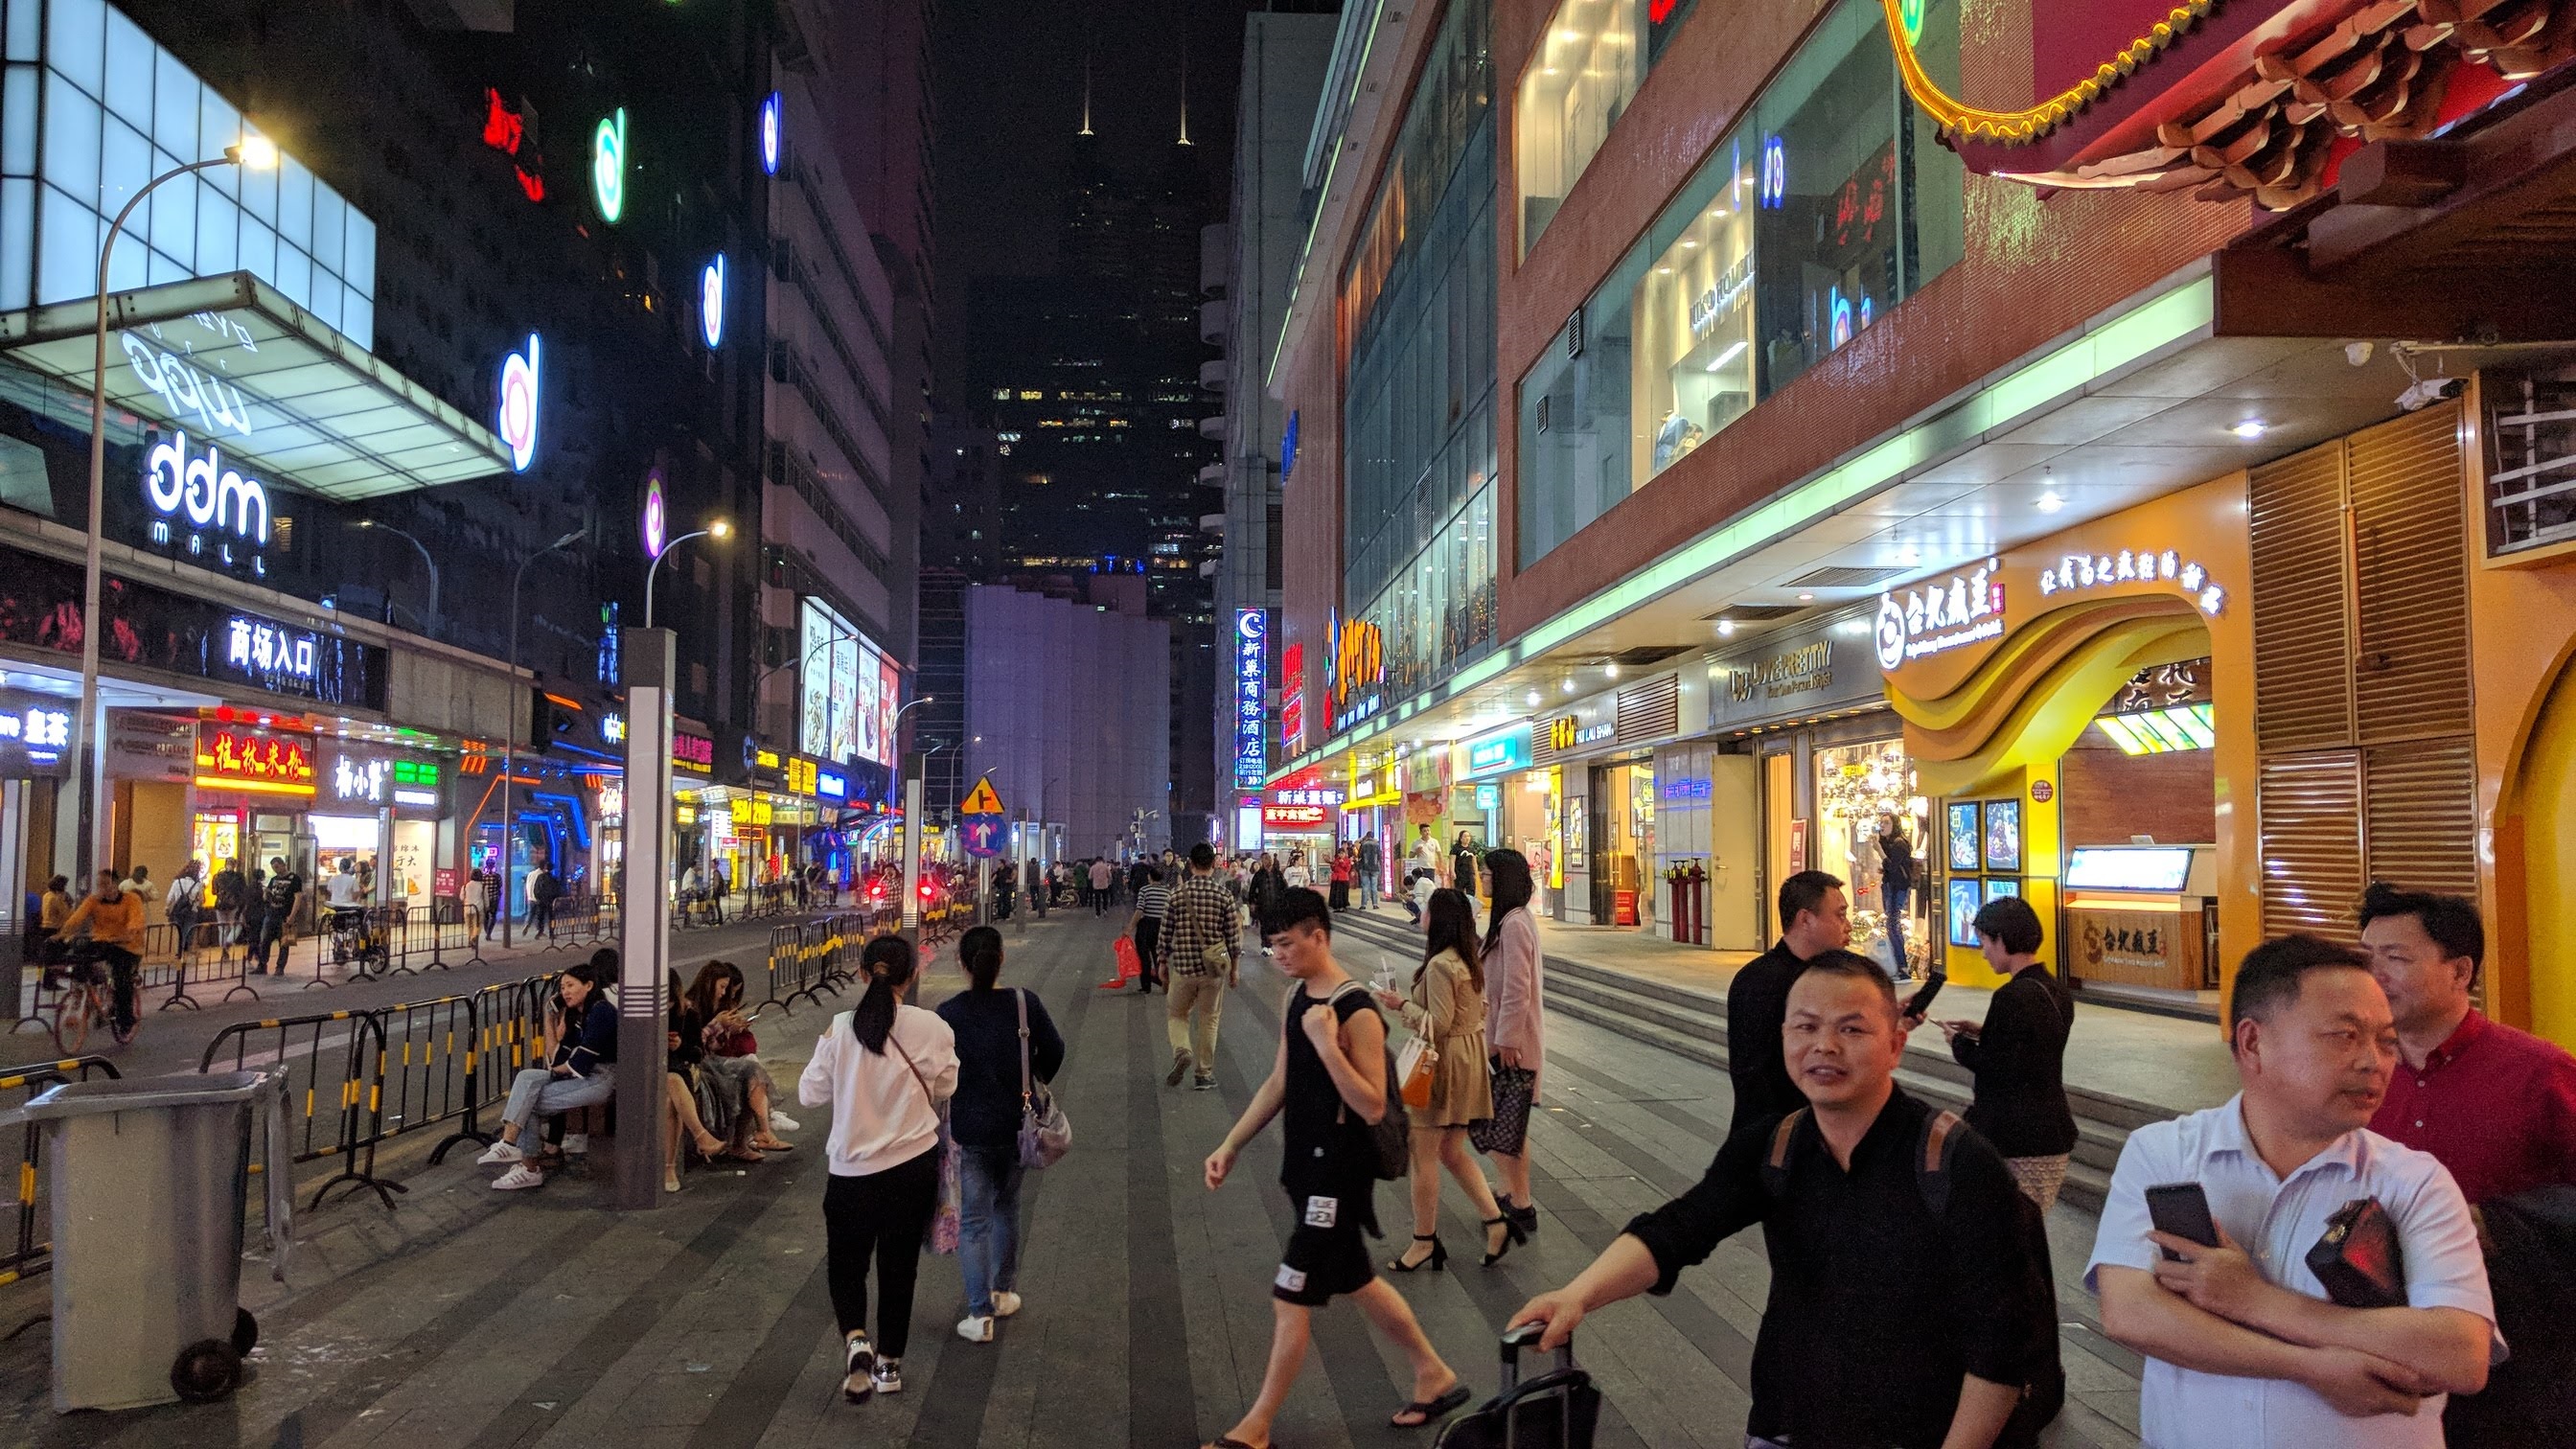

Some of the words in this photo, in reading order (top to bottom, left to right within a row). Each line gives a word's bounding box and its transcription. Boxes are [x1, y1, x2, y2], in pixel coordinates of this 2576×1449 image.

[230, 619, 312, 676] 商场入口
[1241, 639, 1262, 756] 新巢商務酒店
[214, 733, 304, 779] 桂林米粉
